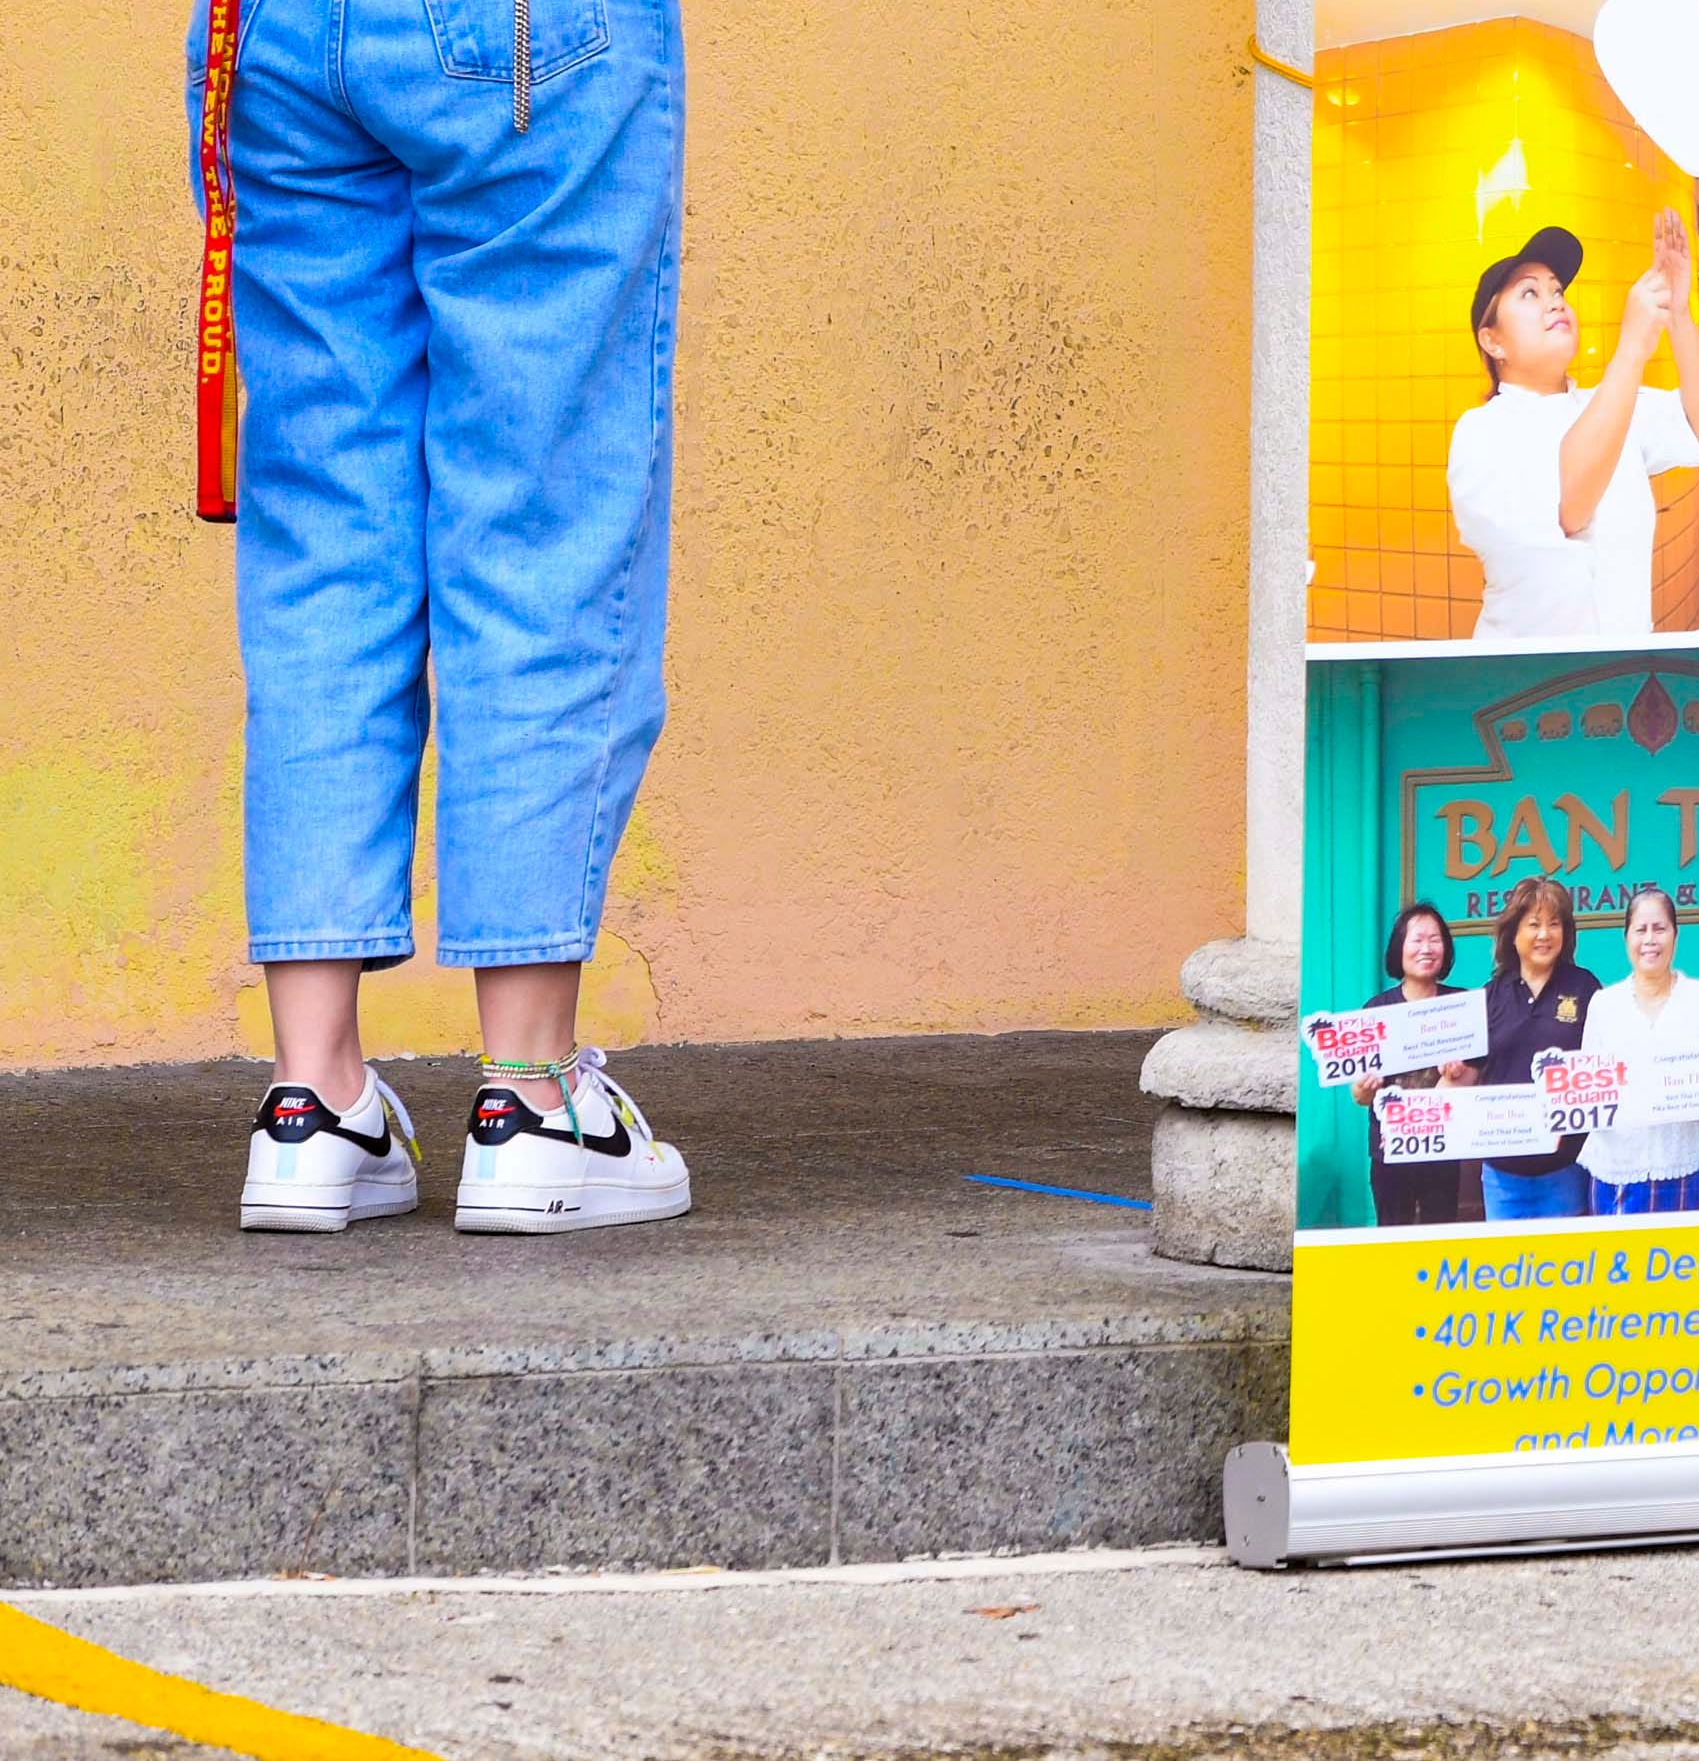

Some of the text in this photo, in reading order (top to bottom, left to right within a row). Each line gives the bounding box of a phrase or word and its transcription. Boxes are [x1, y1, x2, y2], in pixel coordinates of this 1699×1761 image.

[205, 165, 228, 239] THE
[1434, 789, 1630, 881] BAN
[1316, 1020, 1387, 1051] Best
[1334, 1043, 1381, 1060] Guam
[1326, 1052, 1384, 1080] 2014
[1544, 1060, 1628, 1095] Best
[280, 1096, 307, 1110] NIKE
[1564, 1088, 1619, 1106] Guam
[275, 1116, 305, 1127] AIR
[479, 1118, 505, 1129] AIR
[1386, 1102, 1453, 1125] Best
[1550, 1103, 1619, 1133] 2017
[1400, 1123, 1445, 1136] Guam
[1390, 1134, 1446, 1156] 2015
[1434, 1249, 1597, 1293] Medical
[1607, 1250, 1631, 1284] &
[1432, 1309, 1526, 1349] 401K
[1431, 1364, 1571, 1408] Growth
